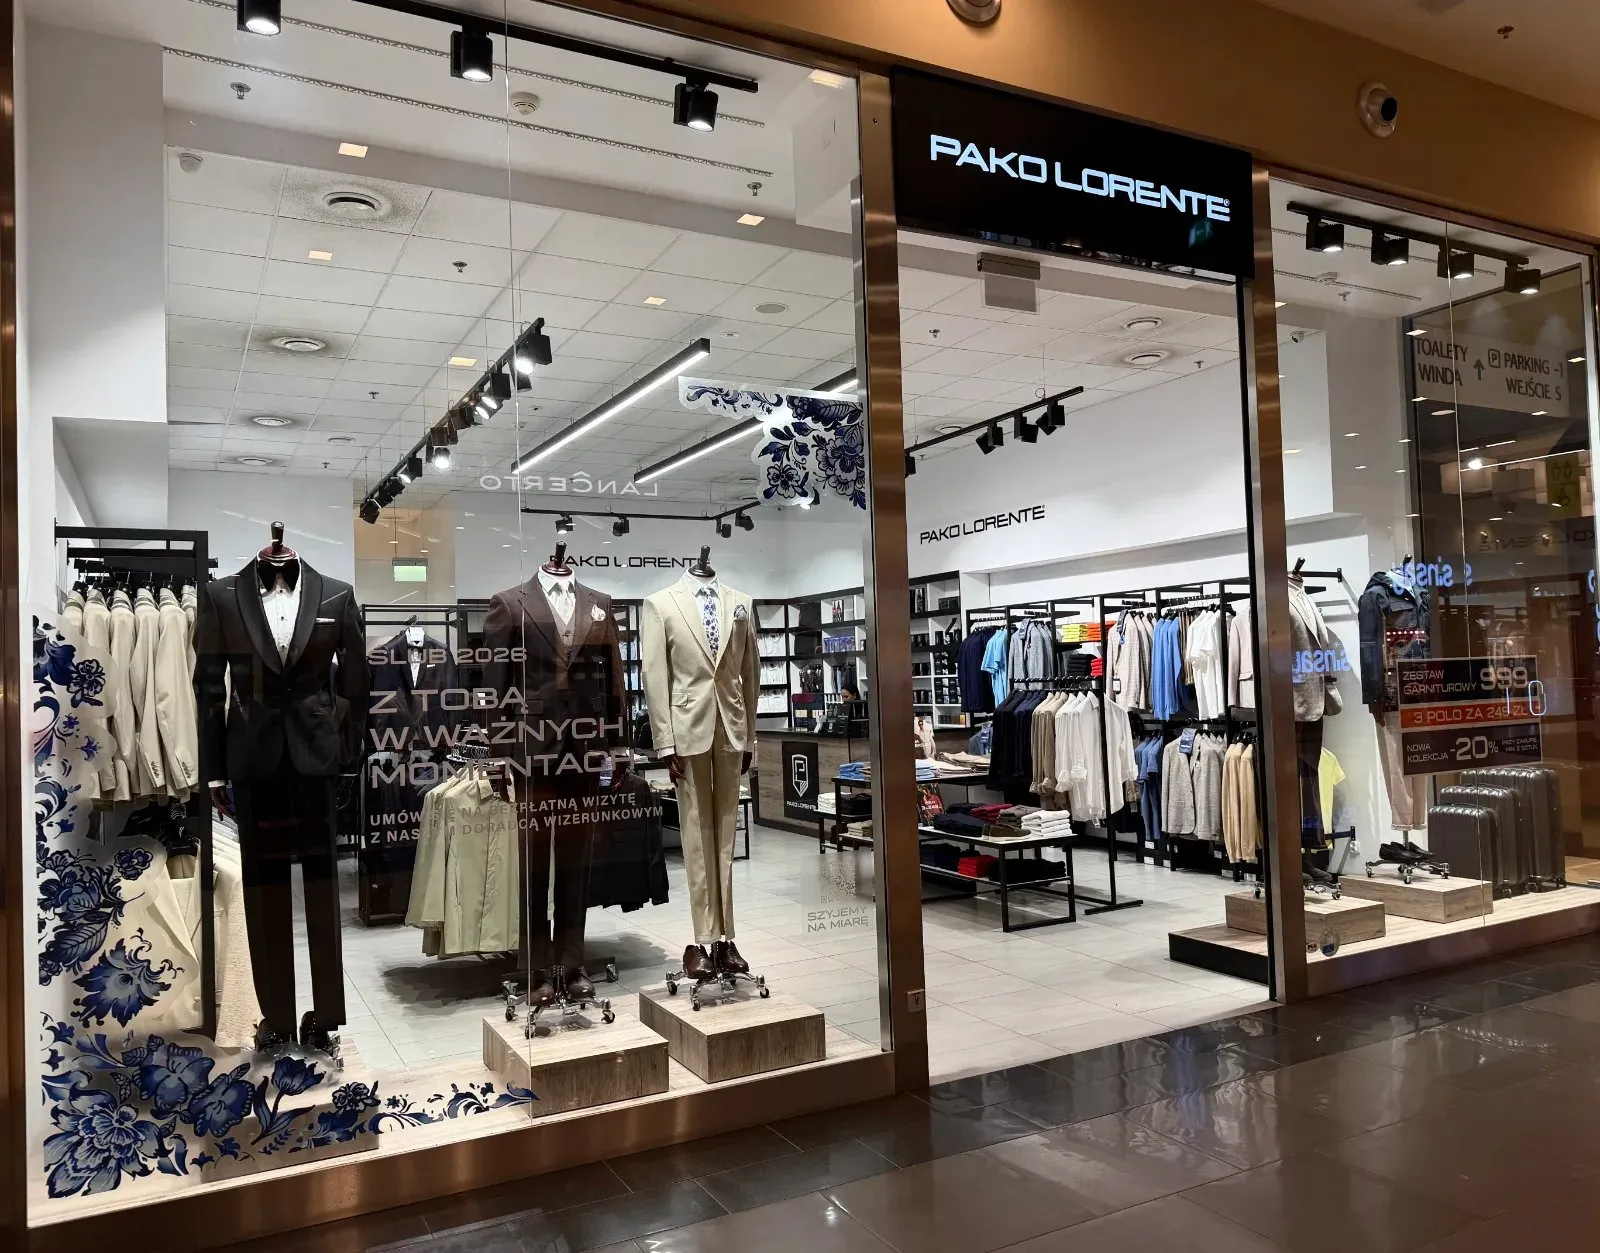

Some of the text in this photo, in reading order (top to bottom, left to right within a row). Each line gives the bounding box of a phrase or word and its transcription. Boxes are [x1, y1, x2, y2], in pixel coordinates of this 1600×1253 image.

[930, 134, 1047, 184] PAKO
[1415, 338, 1468, 362] TOALETY
[1418, 362, 1463, 387] WINDA
[1504, 352, 1550, 375] PARKING
[1506, 375, 1562, 401] WEJŚCIE S
[920, 524, 960, 545] PAKO
[457, 647, 528, 664] 2026
[1402, 669, 1444, 681] ZESTAW
[1480, 666, 1528, 691] 999
[369, 686, 529, 714] Z TOBĄ
[1403, 682, 1477, 695] GARNITUROWY
[1414, 713, 1423, 724] 3
[1427, 710, 1462, 723] POLO
[1465, 708, 1484, 720] ZA
[1513, 704, 1529, 716] ZŁ
[370, 715, 624, 750] W WAŻNYCH
[1406, 742, 1431, 752] NOWA
[1407, 754, 1449, 763] KOLEKCJA
[372, 750, 634, 789] MOMENTACH
[370, 809, 423, 827] UMÓW
[461, 807, 483, 818] NA
[489, 798, 578, 816] BEZPŁATNĄ
[582, 792, 636, 808] WIZYTĘ
[370, 832, 380, 844] Z
[544, 805, 663, 828] WIZERUNKOWYM
[807, 906, 867, 922] SZYJEMY
[808, 916, 869, 933] NA MIARĘ
